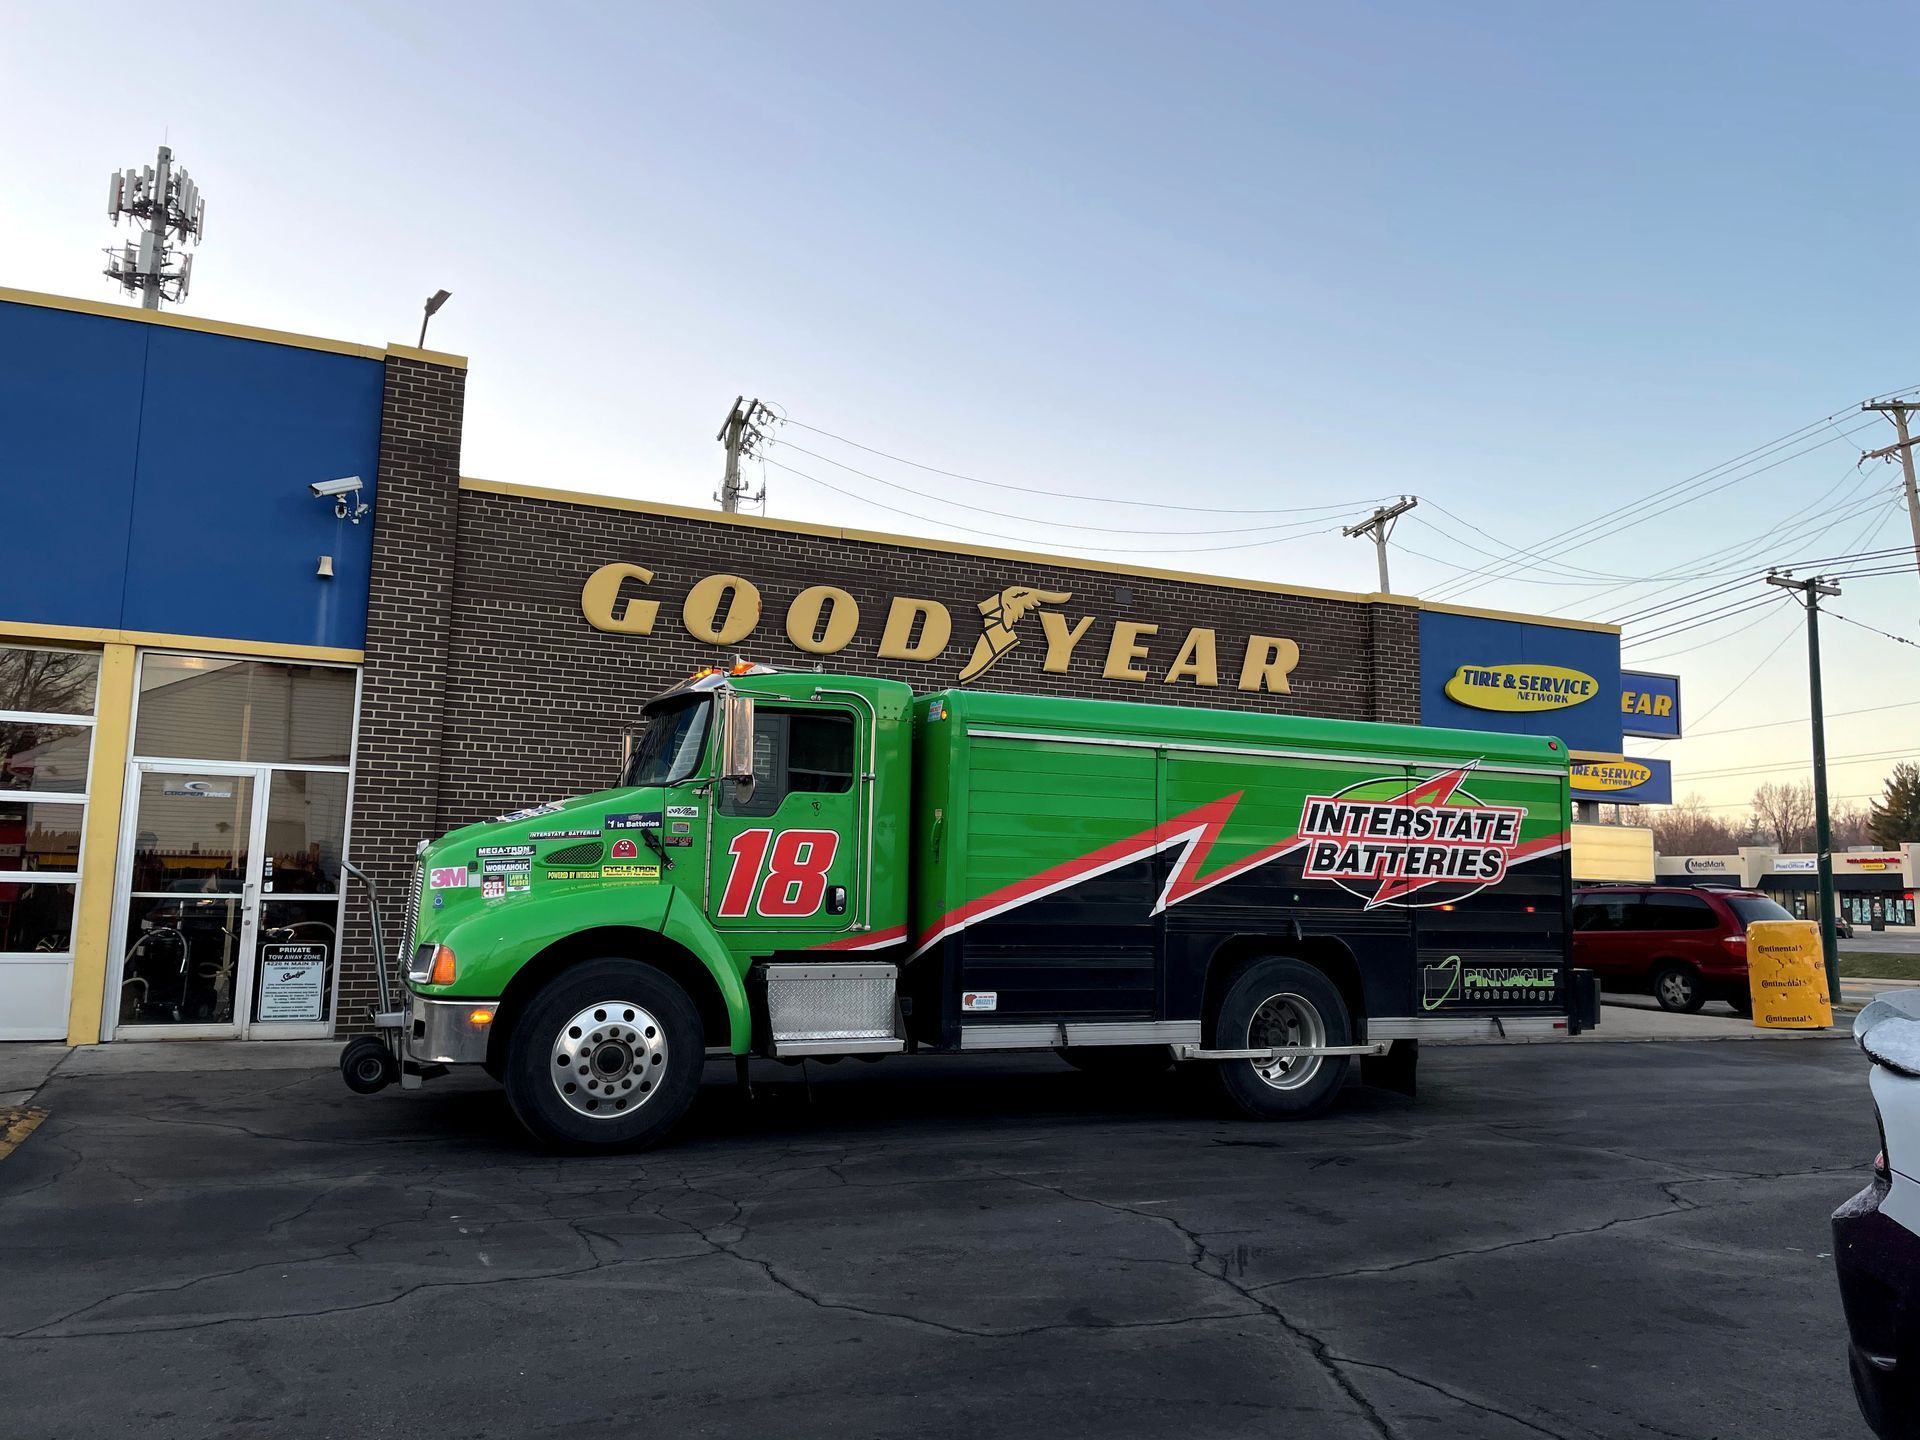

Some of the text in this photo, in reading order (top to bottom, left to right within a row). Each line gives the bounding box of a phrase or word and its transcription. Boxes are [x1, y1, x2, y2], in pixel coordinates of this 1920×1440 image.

[1463, 669, 1590, 695] TIRE & SERVICE
[1517, 691, 1569, 704] NETWORK
[1621, 691, 1673, 717] EAR
[1591, 767, 1600, 777] &
[1601, 767, 1647, 780] SERVICE
[1600, 778, 1632, 786] NETWORK
[626, 820, 660, 828] Batteries
[1304, 803, 1516, 843] INTERSTATE
[529, 830, 566, 838] INTERSTATE
[1309, 841, 1506, 880] BATTERIES
[485, 863, 529, 871] WORKAHOLIC
[717, 828, 840, 918] 18
[431, 867, 467, 888] 3M
[547, 871, 569, 879] POWERED
[576, 870, 600, 878] INTERSTATE
[483, 881, 504, 889] GEL
[483, 888, 505, 897] CELL
[1757, 945, 1798, 954] Continental
[1464, 969, 1555, 986] PINNACLE
[1465, 989, 1555, 1001] Technology
[1765, 1014, 1807, 1024] Continental
